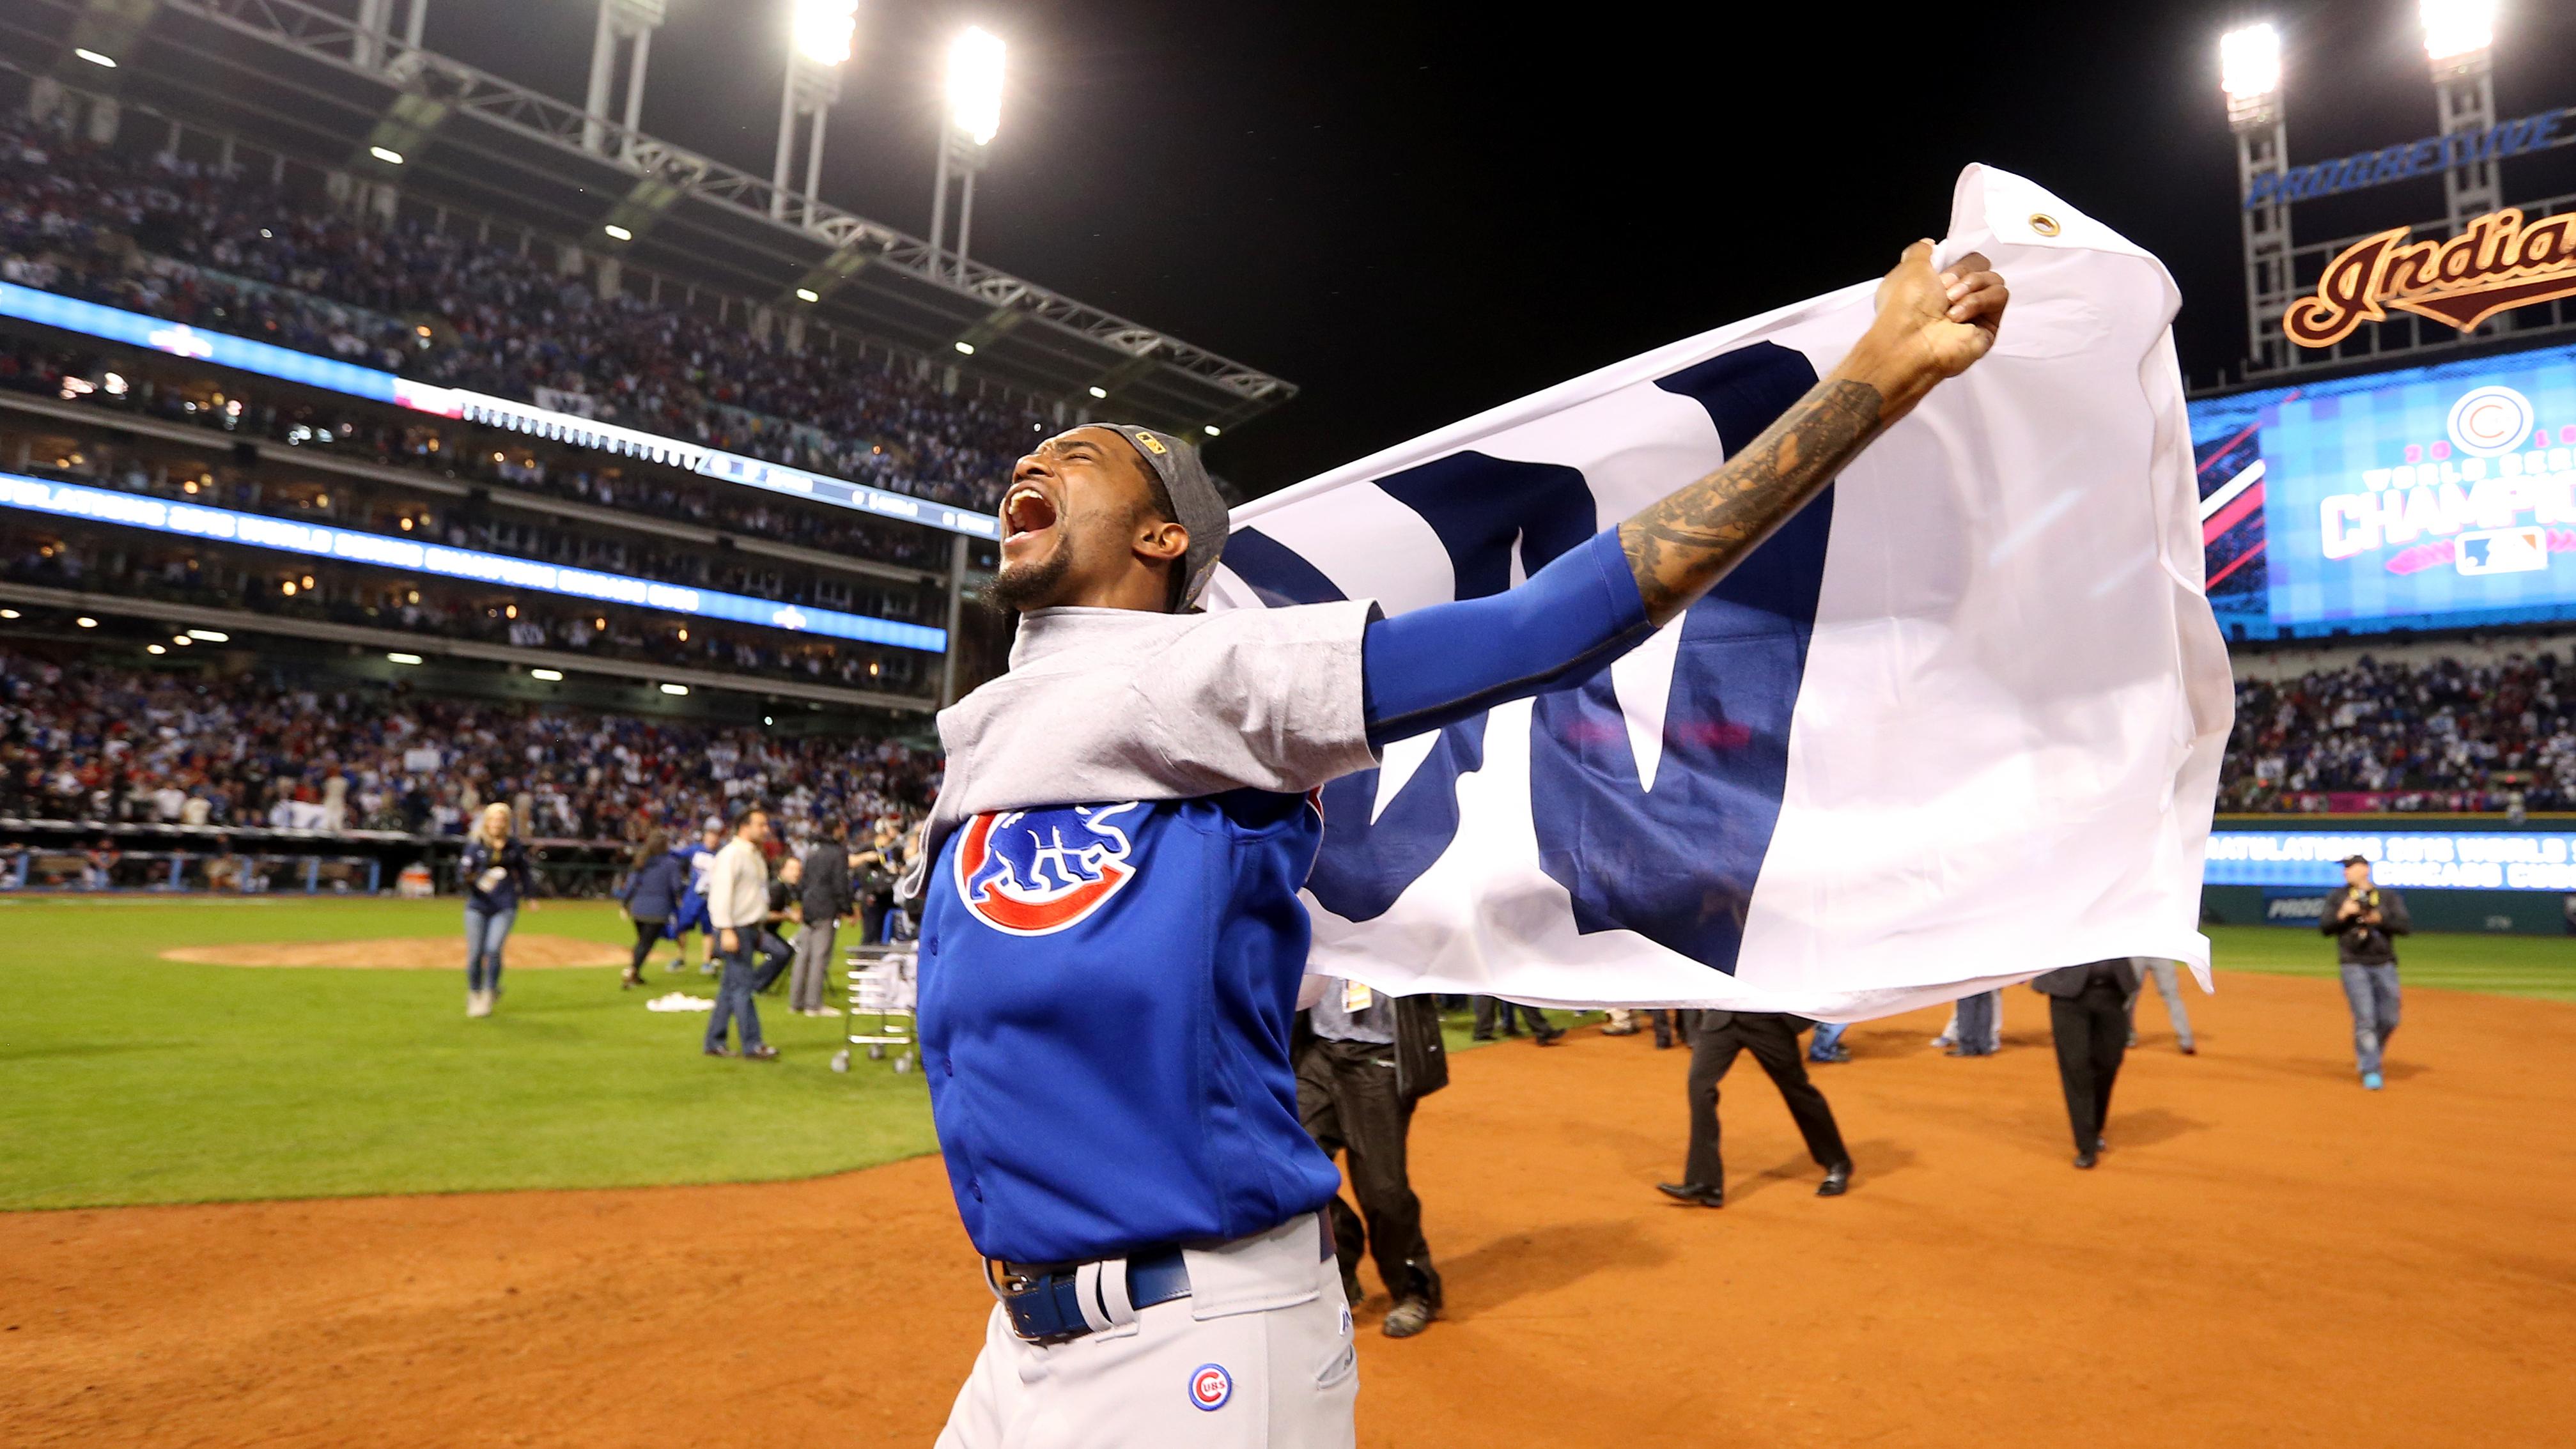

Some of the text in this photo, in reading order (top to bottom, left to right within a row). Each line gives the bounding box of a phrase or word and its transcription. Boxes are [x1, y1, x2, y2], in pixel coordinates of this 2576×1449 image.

[2243, 111, 2564, 208] PROGRESSIVE
[2361, 456, 2487, 492] WORLD
[2456, 837, 2567, 864] WORLD
